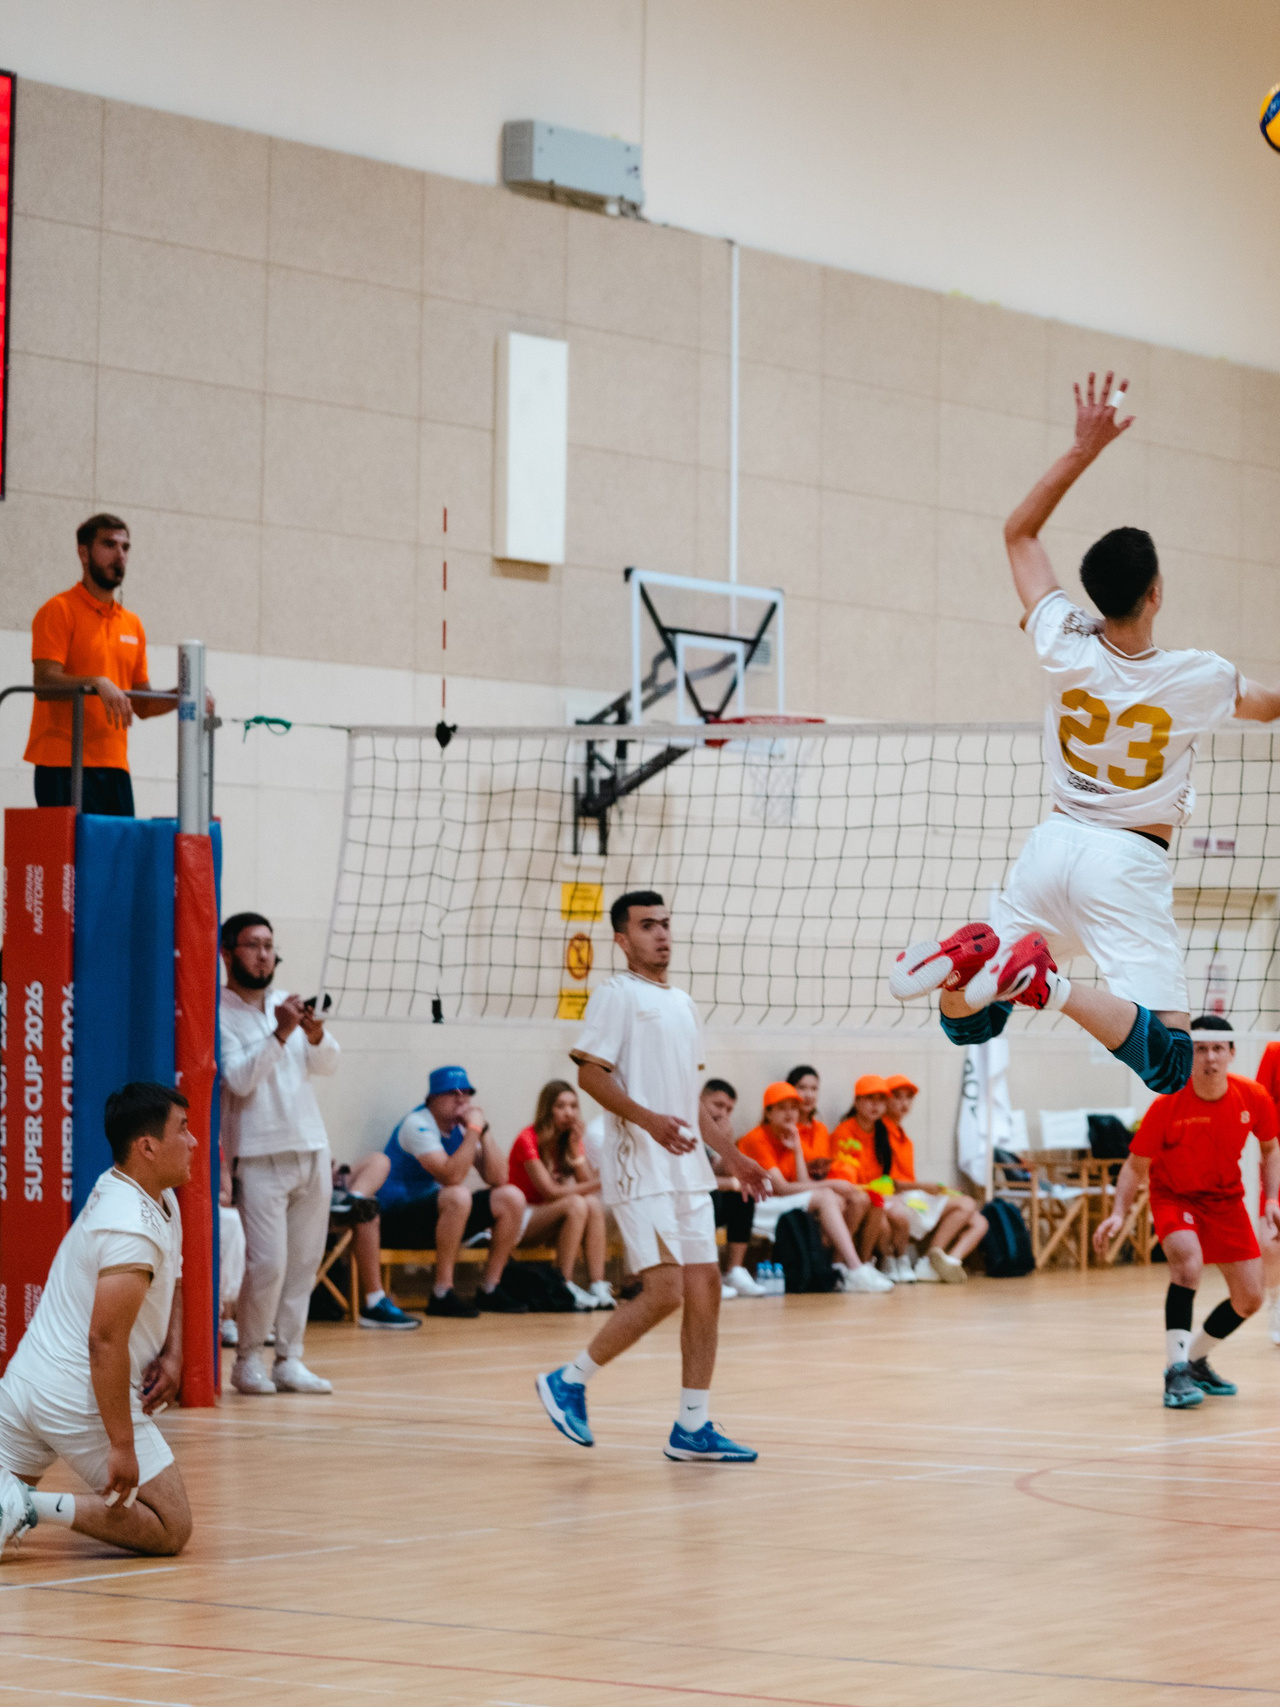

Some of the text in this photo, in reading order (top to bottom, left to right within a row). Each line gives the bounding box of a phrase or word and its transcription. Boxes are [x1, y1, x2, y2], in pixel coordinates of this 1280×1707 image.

[1059, 688, 1173, 790] 23
[25, 864, 34, 912] ASTANA
[34, 865, 44, 935] MOTORS
[24, 980, 43, 1202] SUPER CUP 2026
